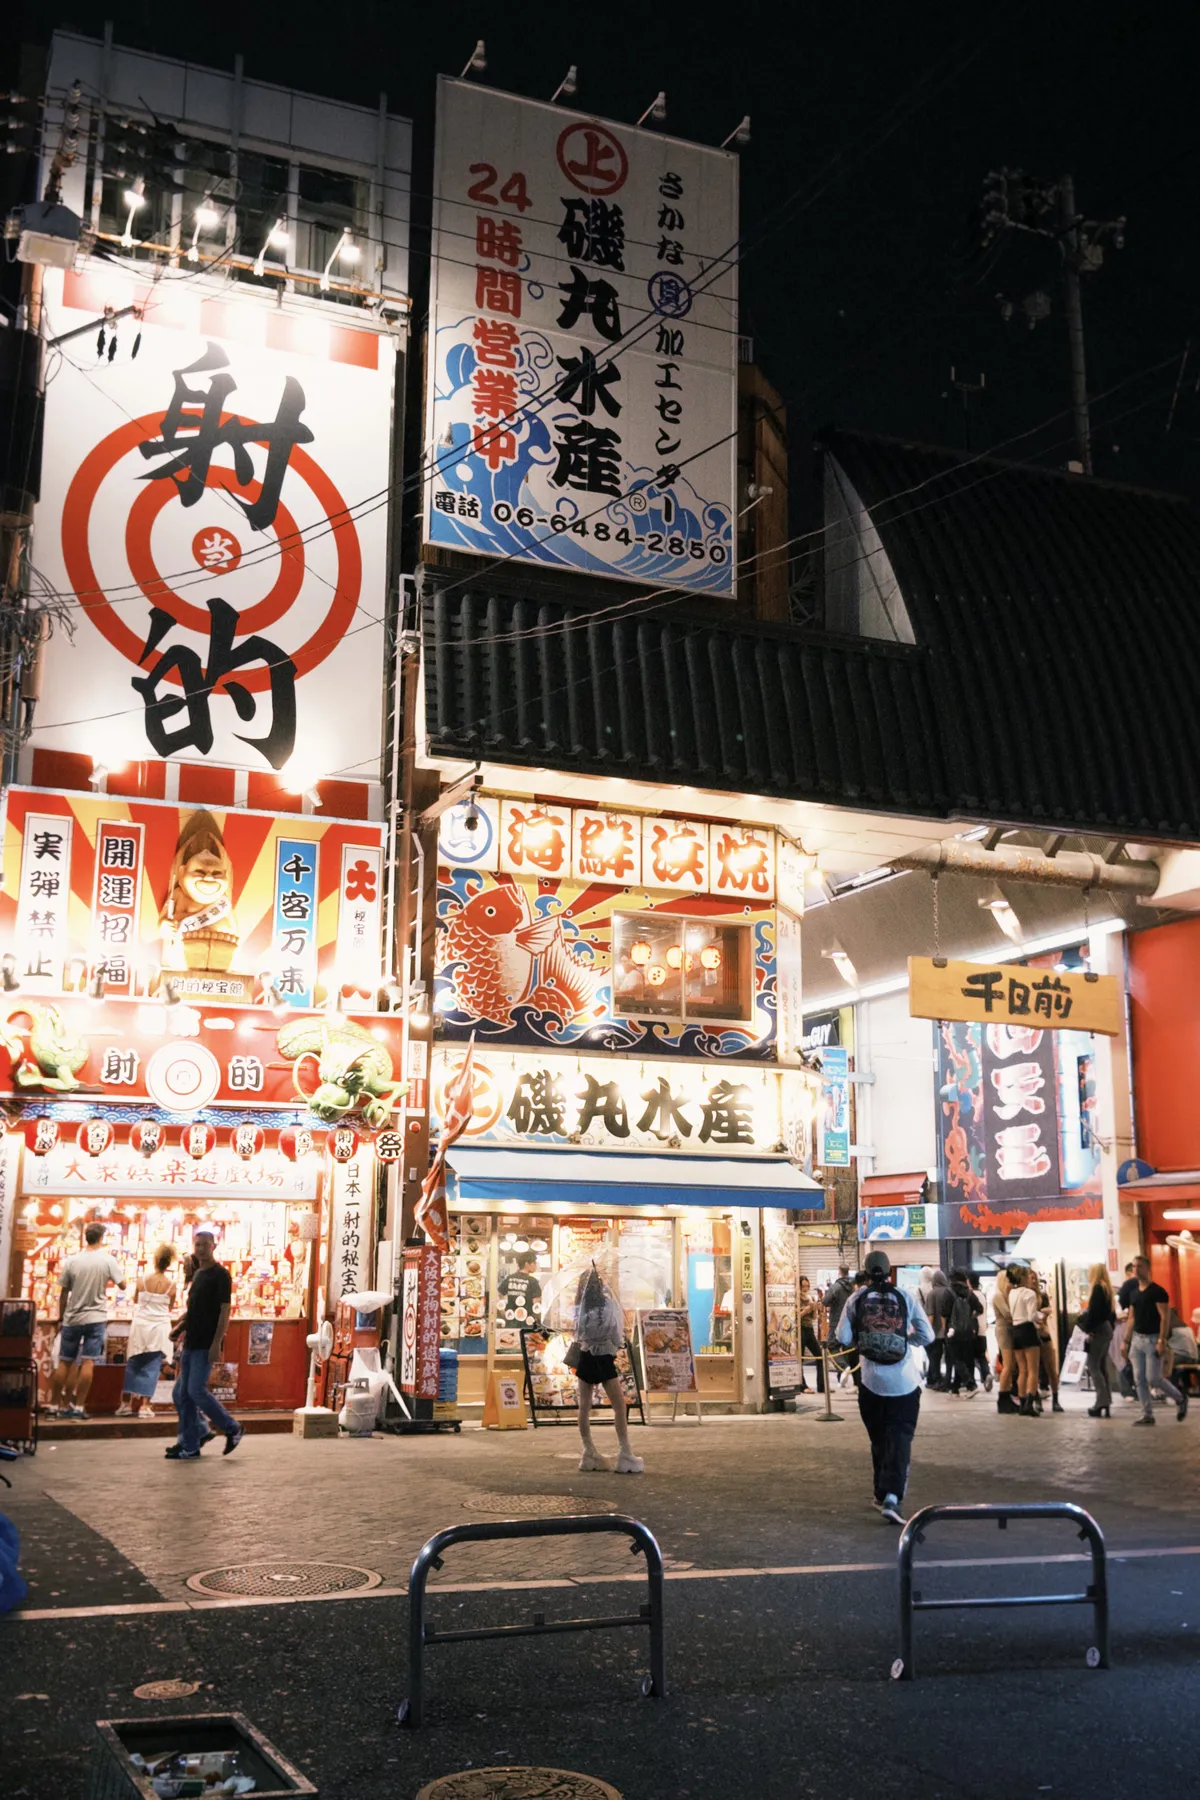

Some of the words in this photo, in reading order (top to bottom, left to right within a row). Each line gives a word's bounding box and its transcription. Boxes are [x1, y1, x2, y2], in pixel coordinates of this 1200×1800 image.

[467, 162, 533, 470] 24時間営業中
[553, 196, 625, 498] 磯丸水産
[200, 532, 233, 569] 当
[434, 491, 480, 520] 電話
[494, 503, 727, 563] 06-6484-2850
[24, 831, 64, 978] 実弾禁止
[98, 836, 136, 988] 開運招福
[277, 854, 312, 995] 千客万来
[961, 971, 1073, 1020] 千日前
[377, 1132, 402, 1158] 祭
[506, 1069, 755, 1145] 磯丸水産
